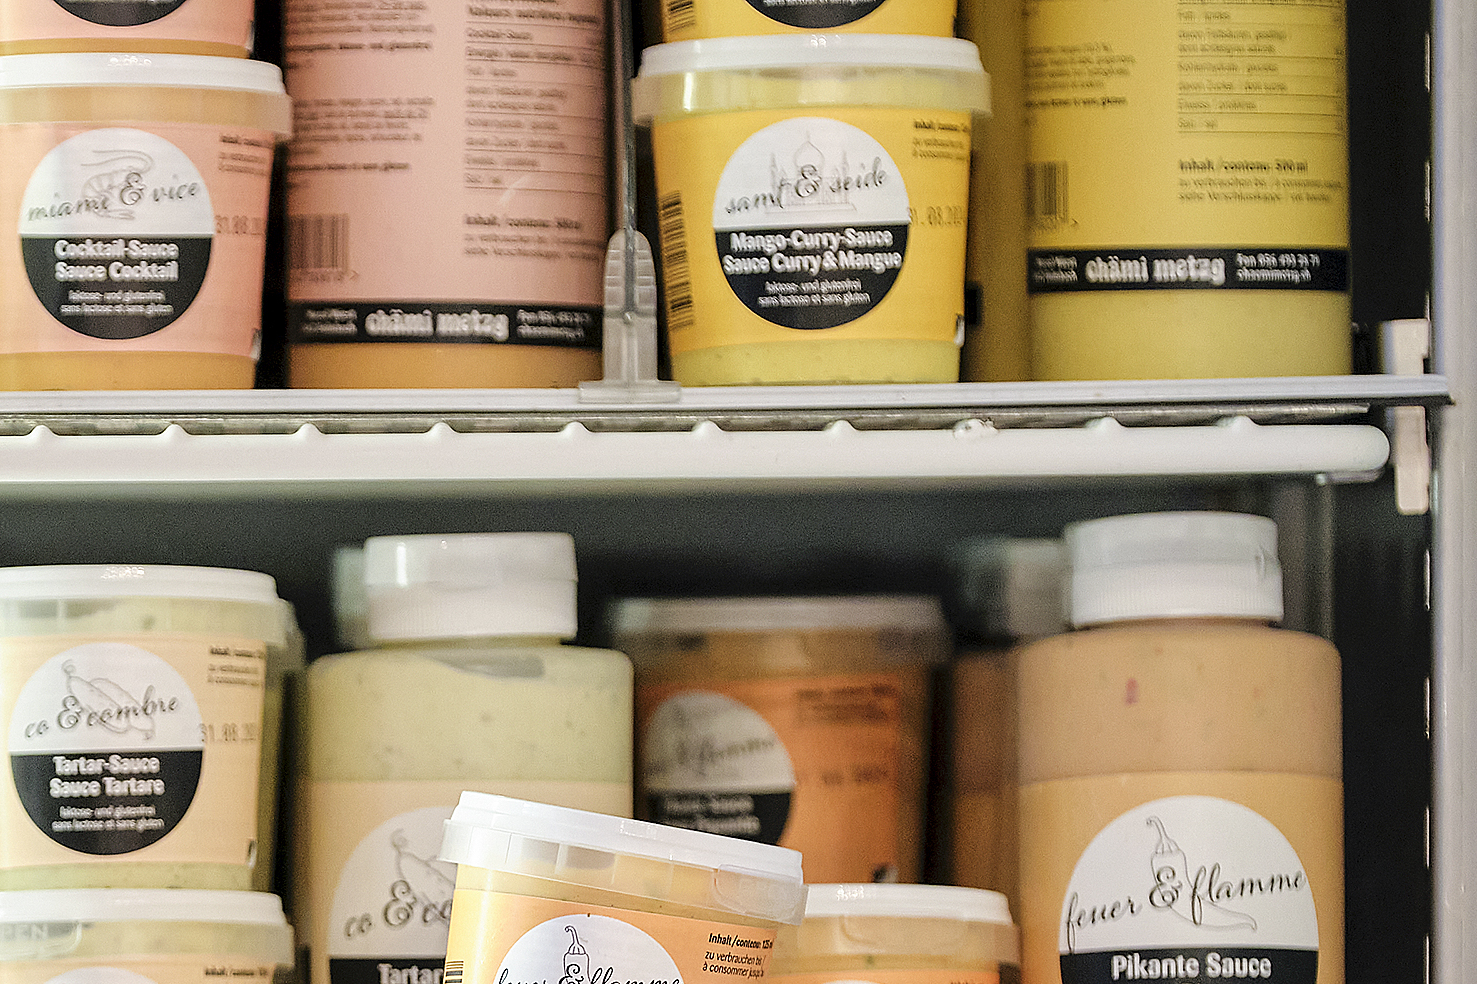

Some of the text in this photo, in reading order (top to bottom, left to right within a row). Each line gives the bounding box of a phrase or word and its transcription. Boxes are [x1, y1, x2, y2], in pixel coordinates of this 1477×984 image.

[795, 164, 822, 198] &
[28, 172, 199, 221] miami & vice
[54, 239, 179, 260] Cocktail-Sauce
[730, 228, 893, 253] Mango-Curry-Sauce
[55, 261, 178, 282] Sauce Cocktail
[723, 250, 902, 276] Sauce Curry & Mangue
[1086, 255, 1226, 286] chämi metzg
[436, 309, 509, 341] metzg
[57, 695, 83, 729] &
[86, 685, 179, 726] combre
[53, 755, 160, 775] Tartar-Sauce
[49, 777, 165, 798] Sauce Tartare
[383, 880, 415, 929] &
[1067, 863, 1306, 953] feuer & flamme
[703, 961, 707, 971] à
[710, 965, 748, 976] consommer
[705, 951, 714, 960] zu
[717, 952, 755, 965] verbrauchen
[1111, 953, 1272, 980] Pikante Sauce
